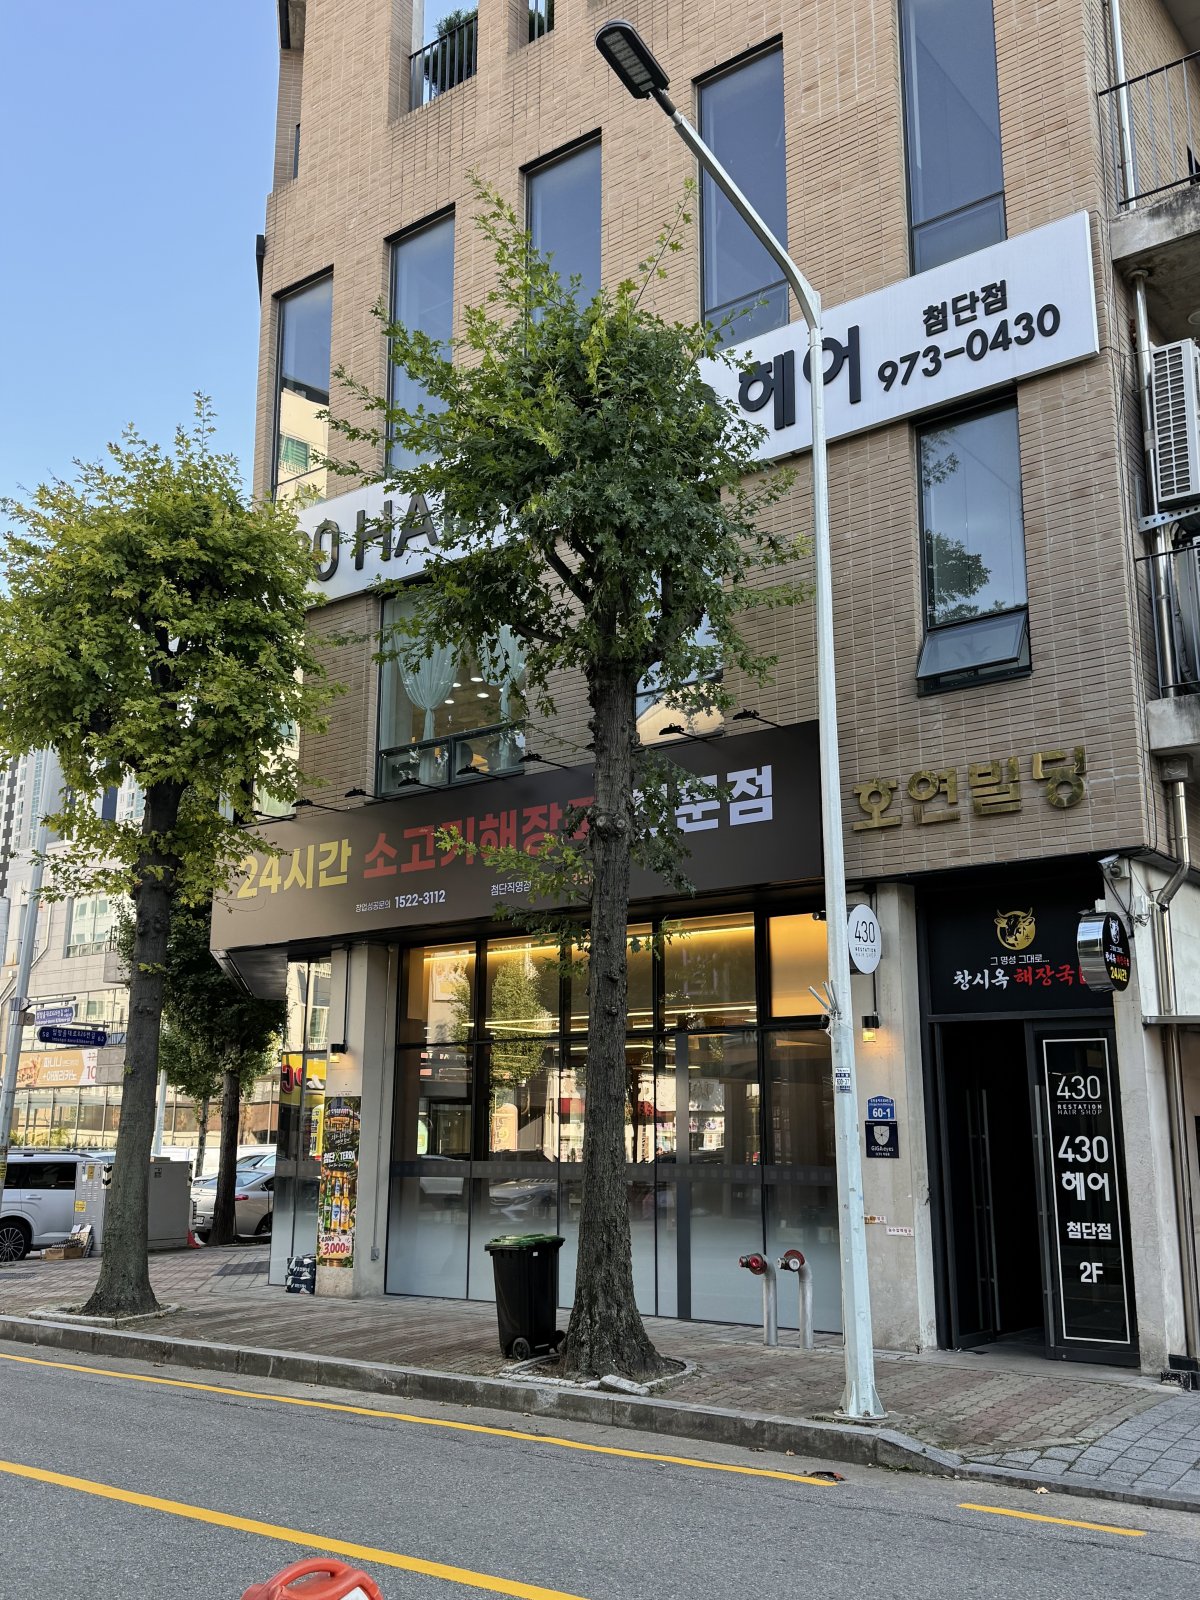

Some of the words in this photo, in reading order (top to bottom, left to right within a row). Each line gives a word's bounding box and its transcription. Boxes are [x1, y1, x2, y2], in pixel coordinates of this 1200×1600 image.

[922, 279, 1008, 337] 첨단점
[877, 303, 1061, 392] 973-0430
[738, 325, 861, 430] 헤어
[853, 746, 1087, 831] 호연빌딩
[237, 838, 352, 898] 24시간
[632, 764, 773, 840] 문점
[394, 889, 446, 909] 1522-3112
[490, 880, 532, 896] 첨단직영점
[855, 920, 876, 943] 430
[990, 957, 999, 966] 그
[1001, 955, 1017, 966] 명성
[953, 968, 1010, 991] 창시옥
[1013, 964, 1075, 986] 해장국
[1110, 967, 1128, 982] 24시간
[1056, 1075, 1101, 1100] 430
[872, 1107, 891, 1118] 60-1
[1057, 1136, 1109, 1163] 430
[1061, 1171, 1111, 1201] 헤어
[1066, 1221, 1112, 1240] 첨단점
[323, 1243, 351, 1256] 3,000원
[1079, 1261, 1104, 1284] 2F
